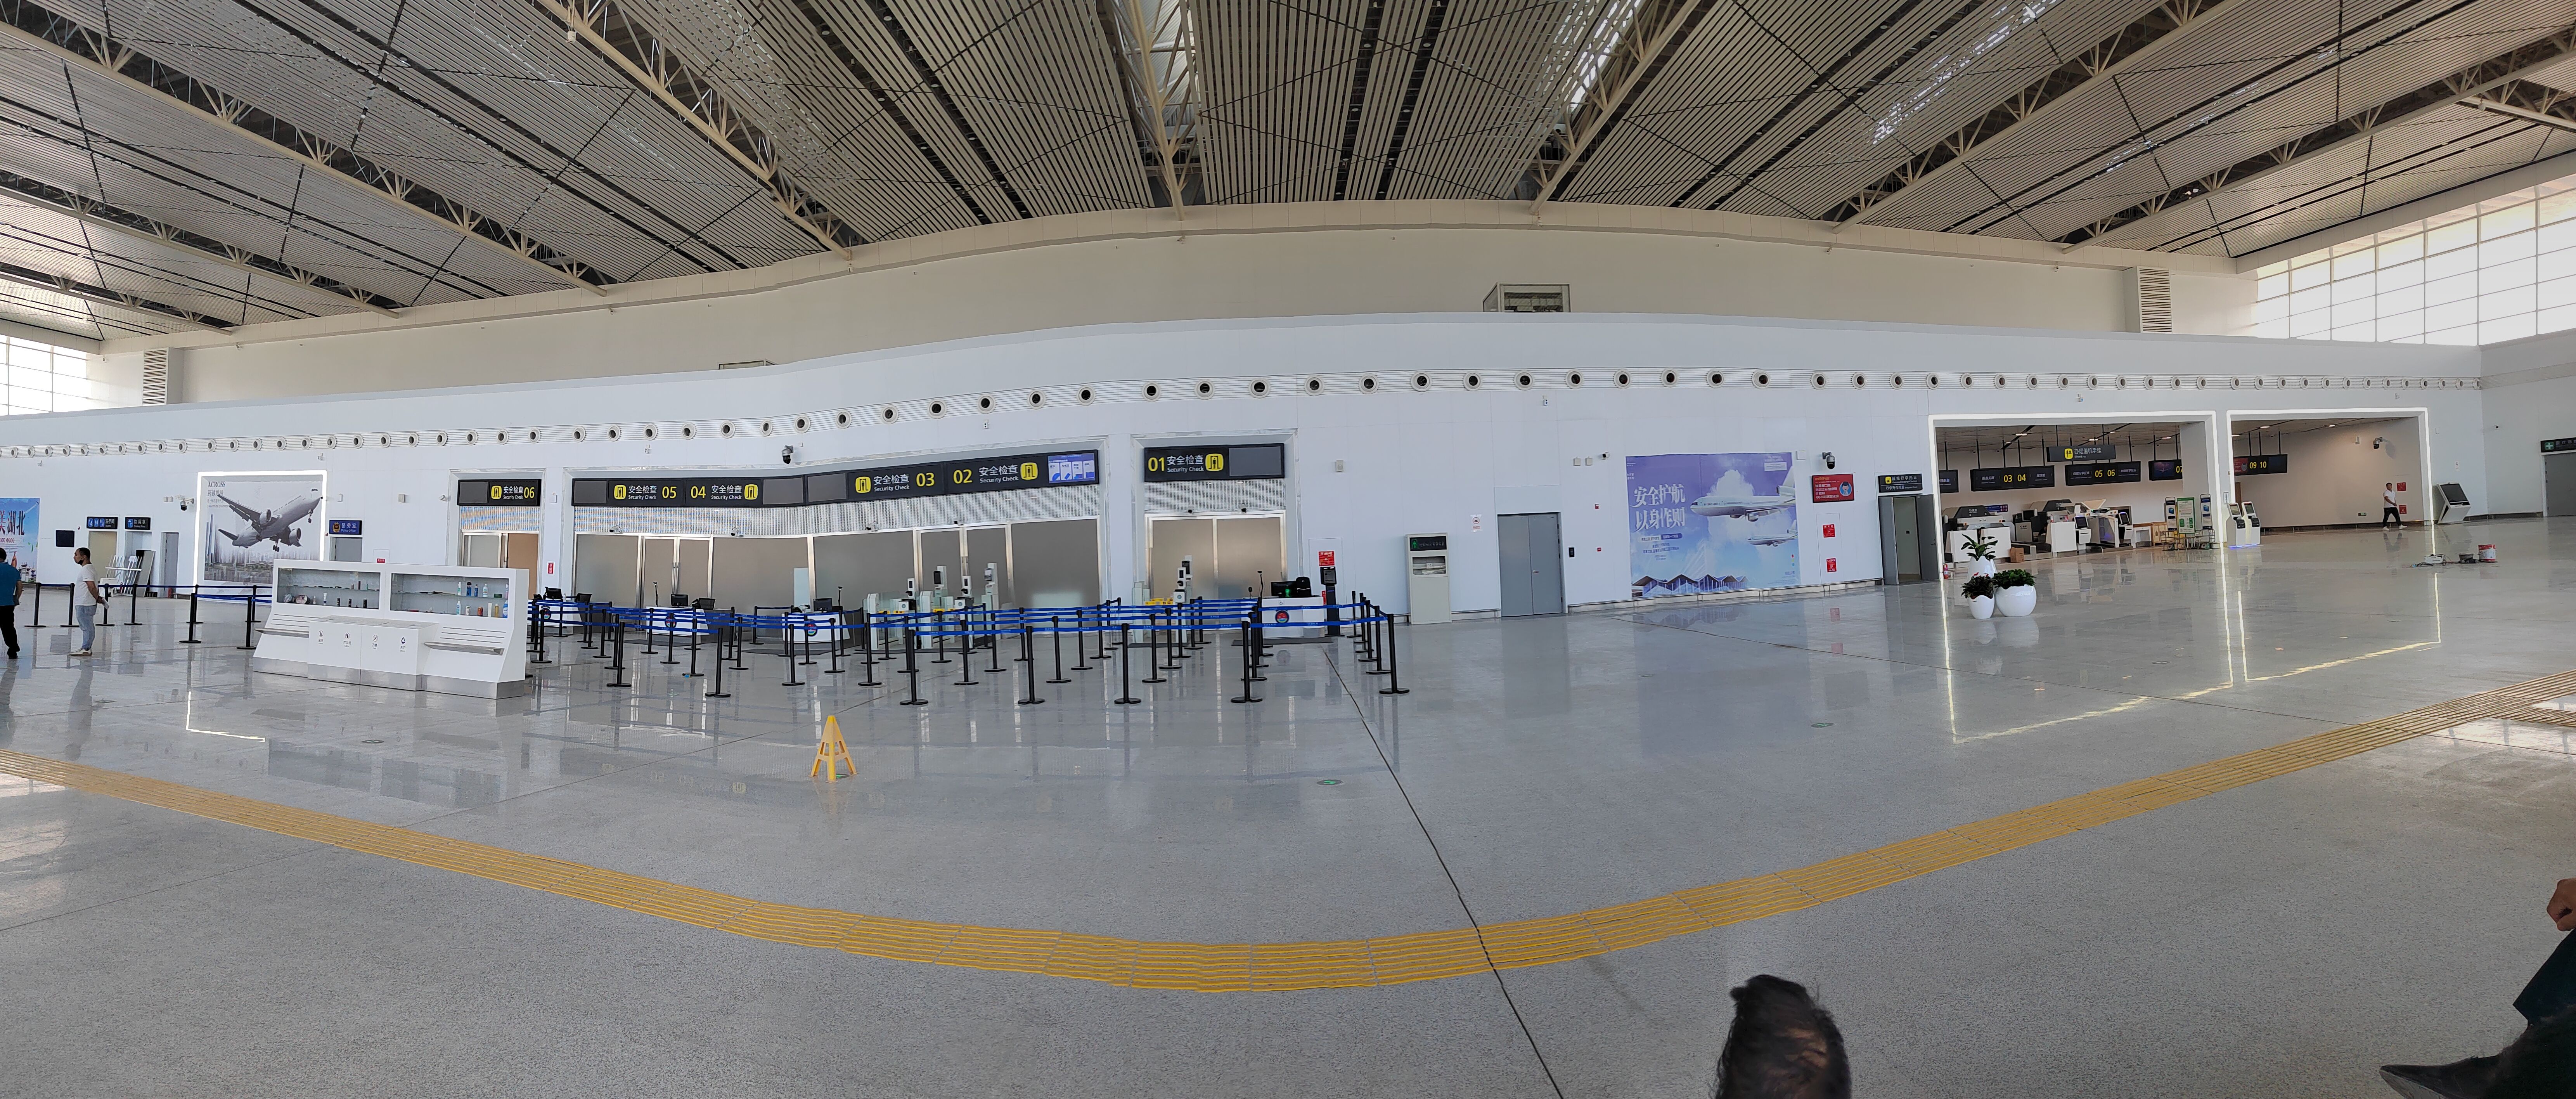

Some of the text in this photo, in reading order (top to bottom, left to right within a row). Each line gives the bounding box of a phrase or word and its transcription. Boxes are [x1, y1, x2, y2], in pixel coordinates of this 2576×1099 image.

[1148, 457, 1164, 471] 01
[1167, 455, 1204, 465] 安全检查
[953, 469, 972, 484] 02
[979, 465, 1018, 477] 安全检查
[874, 474, 909, 485] 安全检查
[916, 472, 935, 487] 03
[524, 487, 535, 498] 06
[628, 485, 657, 494] 安全检查
[662, 486, 677, 499] 05
[691, 486, 706, 498] 04
[711, 485, 742, 494] 安全检查
[1630, 484, 1686, 507] 安全护航
[1633, 507, 1686, 532] 以身作则
